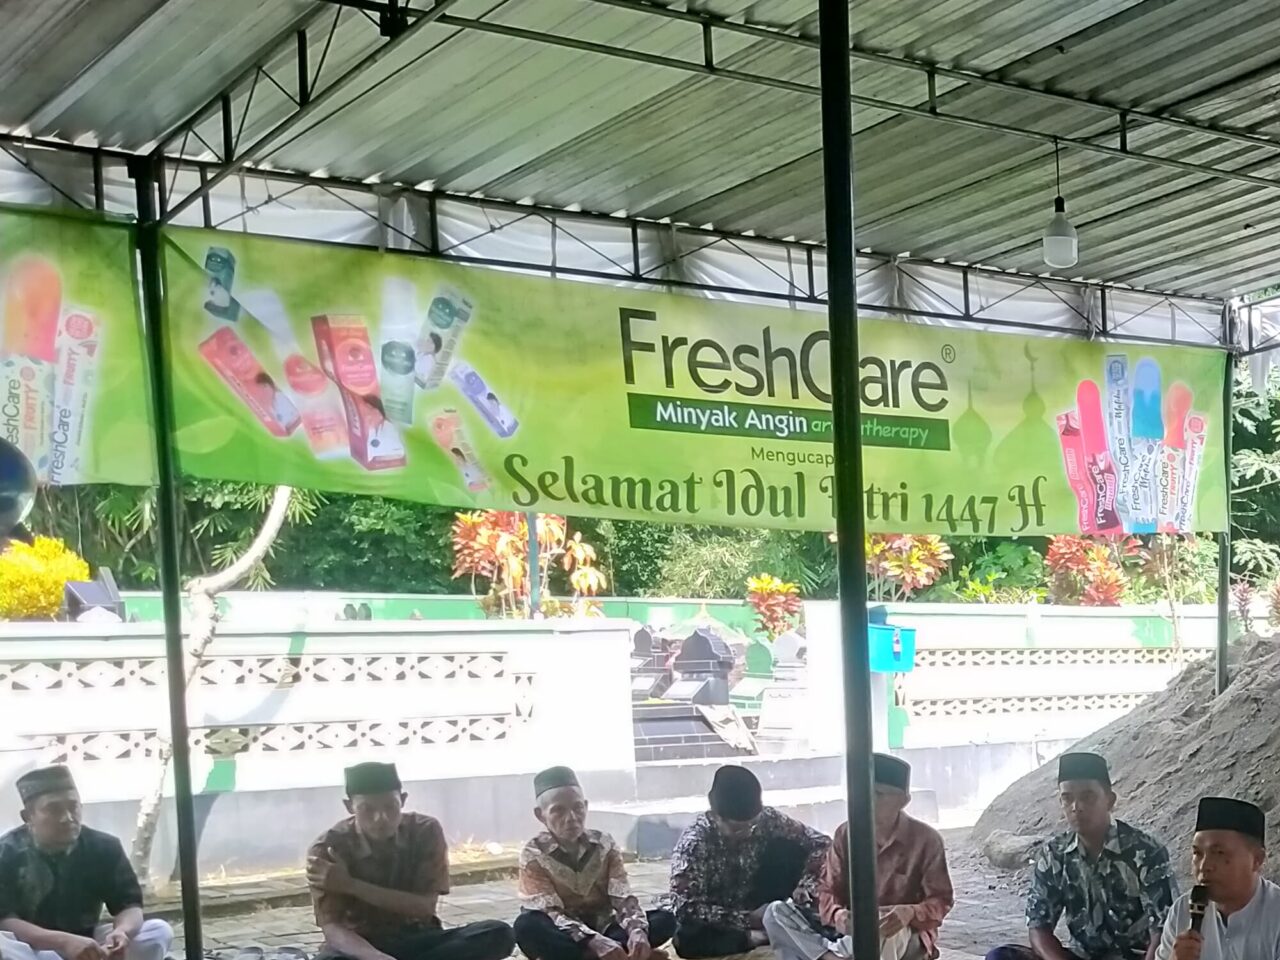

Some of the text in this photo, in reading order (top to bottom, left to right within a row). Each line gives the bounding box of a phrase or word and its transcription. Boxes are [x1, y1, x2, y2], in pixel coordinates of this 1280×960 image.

[655, 400, 929, 447] Minyak Angin artherapy
[751, 446, 836, 467] Mengucap
[503, 453, 703, 514] Selamat
[713, 468, 806, 519] Idul
[921, 493, 999, 534] 1447
[1007, 475, 1048, 533] H
